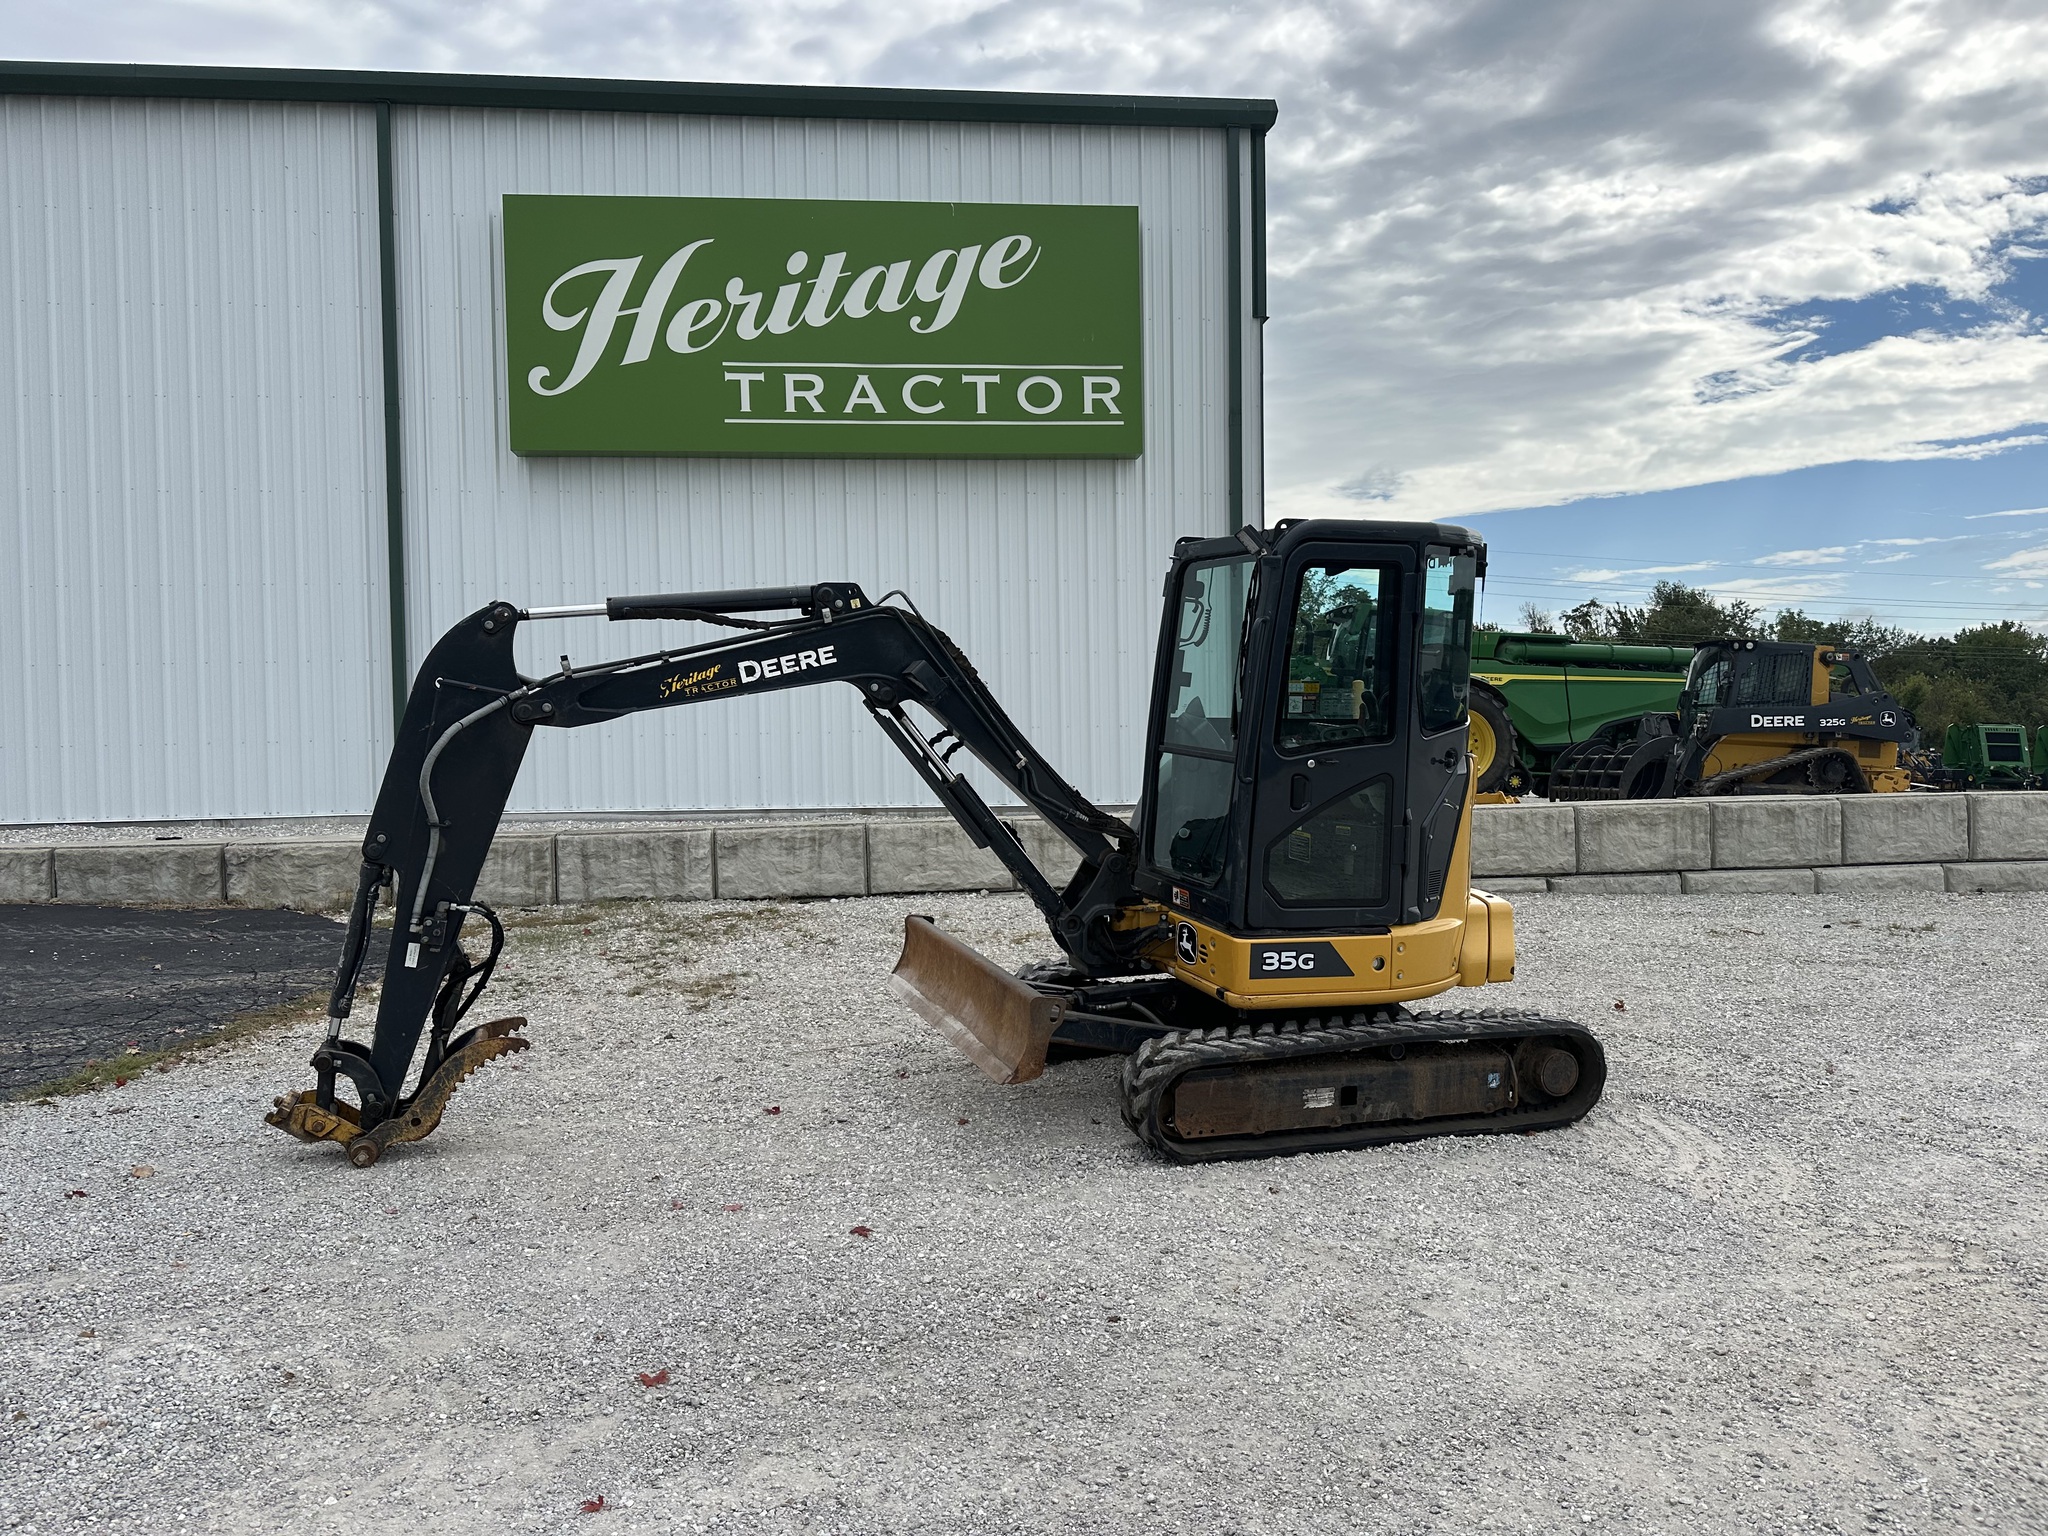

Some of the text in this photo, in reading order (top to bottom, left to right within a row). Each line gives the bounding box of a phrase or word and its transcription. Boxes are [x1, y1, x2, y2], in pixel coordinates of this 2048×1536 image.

[527, 233, 1042, 397] Heritage
[724, 371, 1122, 415] TRACTOR
[660, 664, 721, 699] Heritage
[738, 645, 838, 684] DEERE
[684, 680, 737, 696] TRACTOR
[1750, 714, 1805, 728] DEERE
[1819, 718, 1846, 727] 325G
[1262, 951, 1315, 971] 35G
